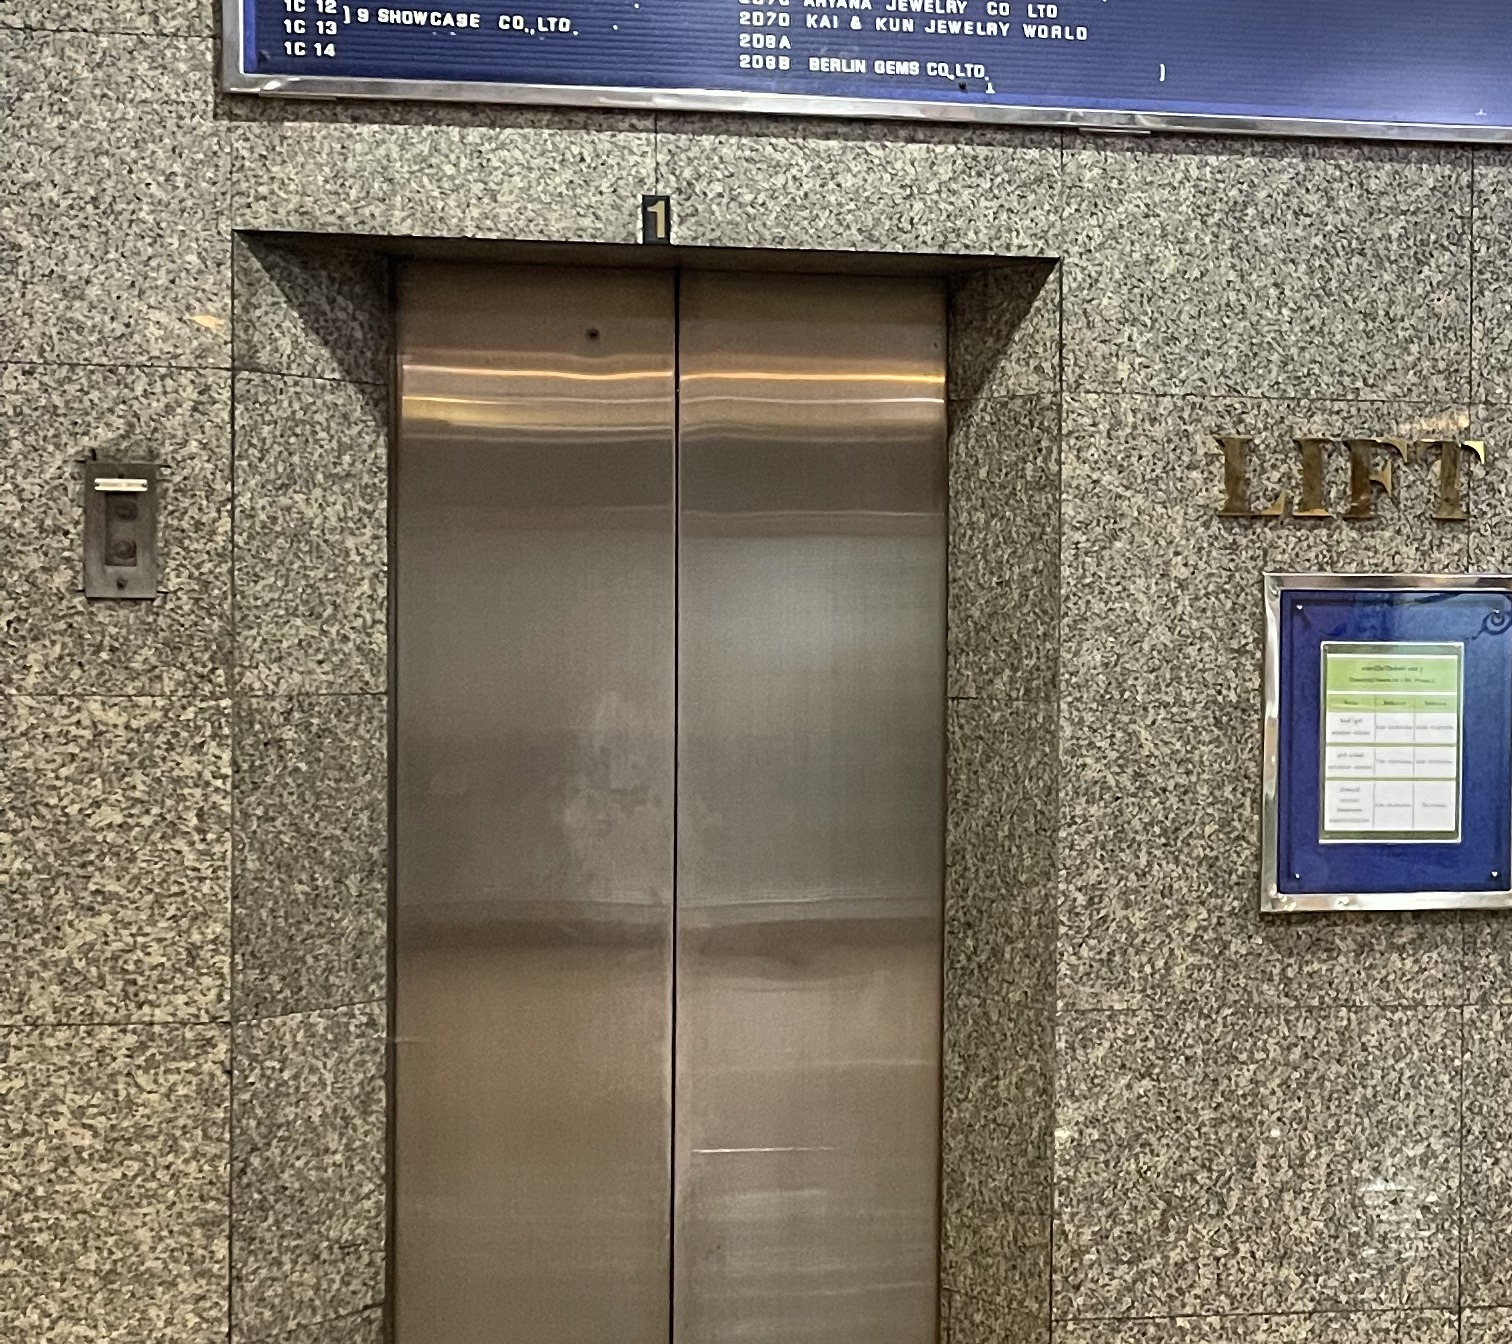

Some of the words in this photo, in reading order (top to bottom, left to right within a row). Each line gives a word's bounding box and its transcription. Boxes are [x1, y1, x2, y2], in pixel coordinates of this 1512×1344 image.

[357, 8, 369, 22] 9
[378, 8, 480, 28] SHOWCASE
[987, 1, 1009, 16] CO
[1028, 4, 1057, 18] LTD
[806, 14, 838, 28] KAI
[850, 16, 862, 29] &
[876, 17, 914, 32] KUN
[924, 20, 1010, 36] JEWELRY
[1023, 24, 1087, 40] WORLD
[740, 33, 791, 49] 208A
[809, 57, 866, 73] BERLIN
[874, 60, 919, 75] GEMS
[647, 200, 665, 239] 1
[1214, 436, 1484, 519] LIFT
